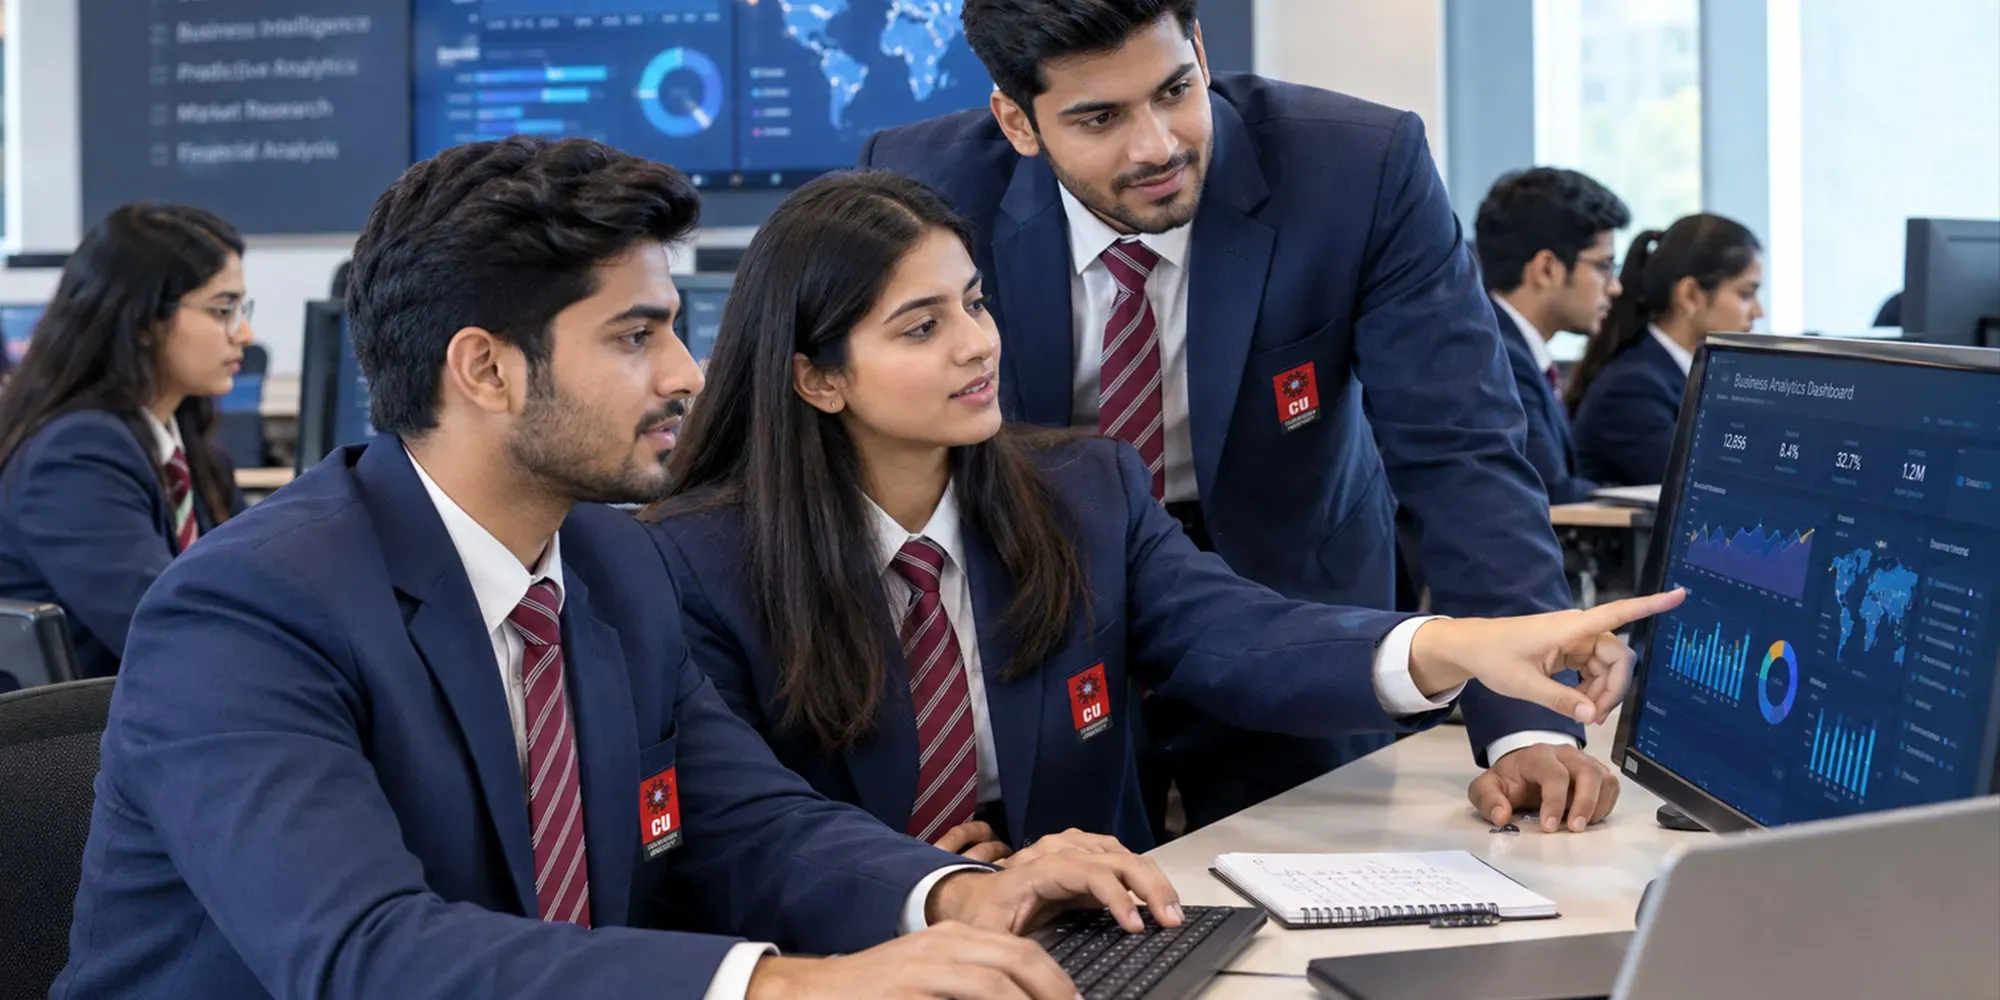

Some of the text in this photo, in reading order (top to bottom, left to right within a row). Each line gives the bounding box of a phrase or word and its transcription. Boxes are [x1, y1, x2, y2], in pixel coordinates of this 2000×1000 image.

[177, 15, 371, 44] Business Intelligence
[177, 58, 359, 82] Predictive Analytics
[177, 98, 334, 123] Market Research
[177, 142, 259, 163] Financial
[1734, 373, 1856, 400] Business Analytics Dashboard
[1288, 396, 1309, 416] CU
[1779, 443, 1800, 460] 8.4%
[1835, 452, 1863, 471] 32.7%
[1902, 462, 1926, 482] 1.2M
[1082, 702, 1102, 723] CU
[651, 813, 672, 836] CU
